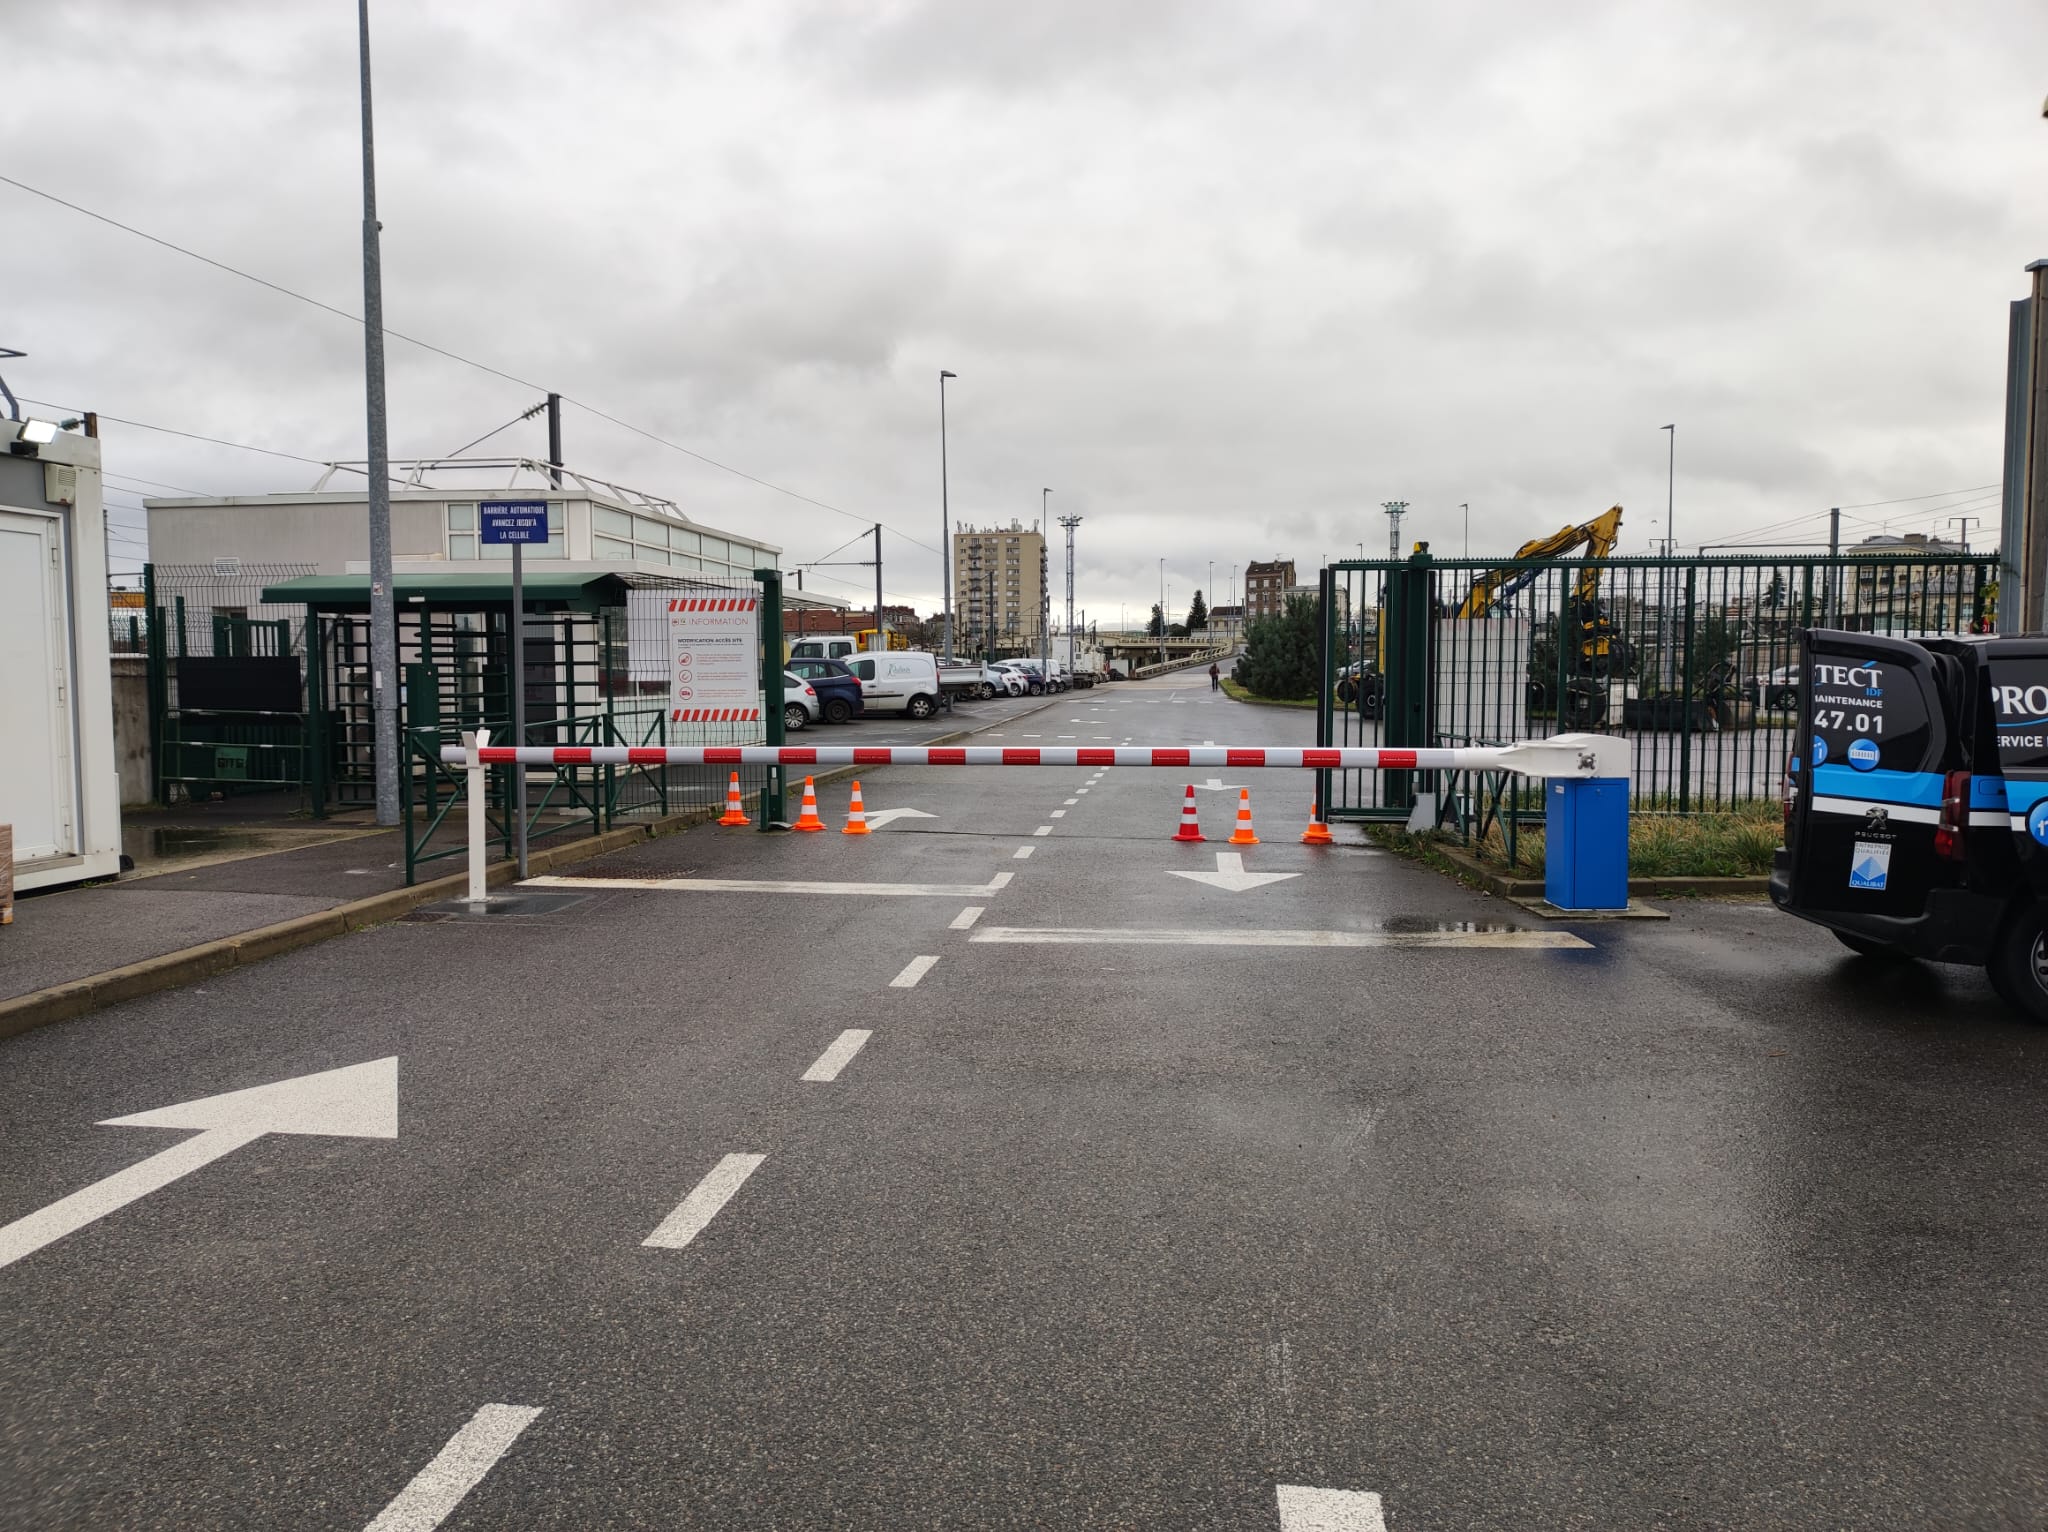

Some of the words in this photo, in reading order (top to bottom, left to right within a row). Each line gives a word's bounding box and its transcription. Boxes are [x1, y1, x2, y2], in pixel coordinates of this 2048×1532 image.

[484, 506, 508, 514] BARRIÈRE
[510, 506, 544, 514] AUTOMATIQUE
[500, 531, 507, 539] LA
[508, 531, 529, 539] CELLULE
[689, 617, 748, 626] INFORMATION
[1865, 688, 1884, 697] IDF
[1814, 709, 1883, 734] 47.01
[1854, 831, 1897, 840] PEUGEOT
